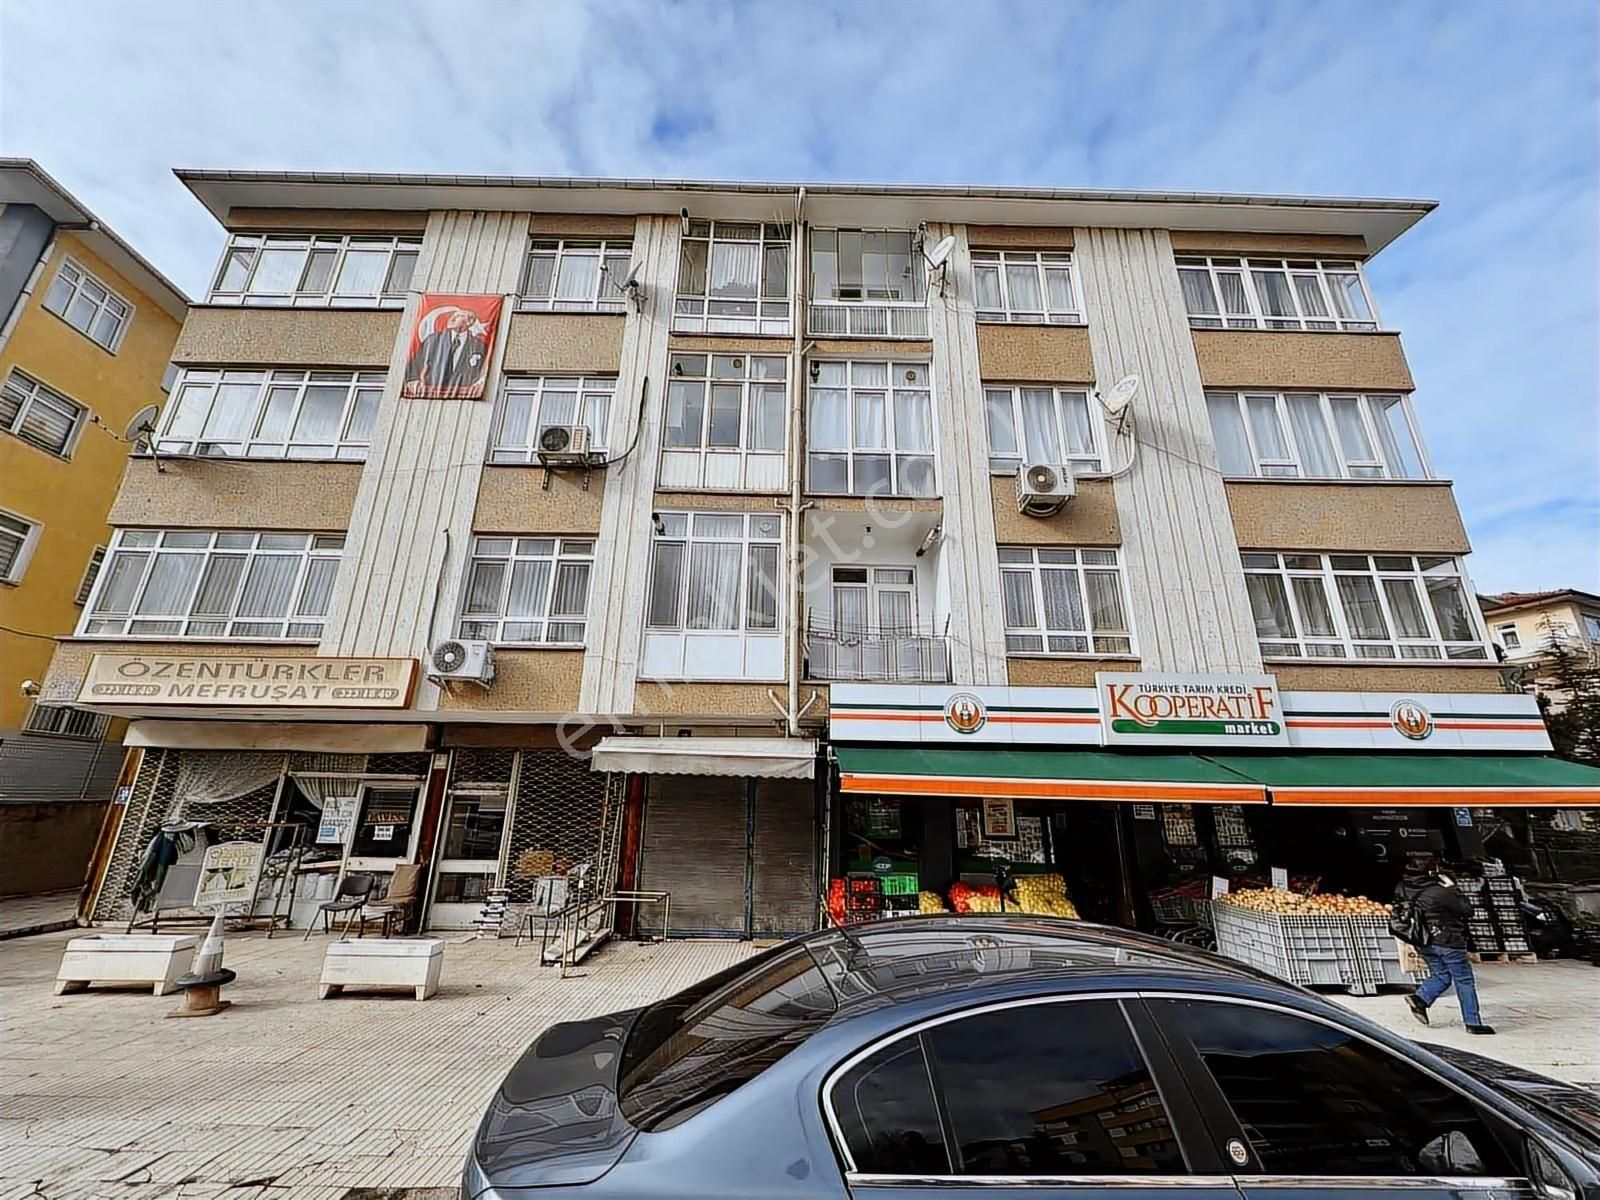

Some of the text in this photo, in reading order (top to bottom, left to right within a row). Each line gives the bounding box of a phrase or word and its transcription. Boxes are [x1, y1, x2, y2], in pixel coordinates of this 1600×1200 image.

[118, 657, 386, 681] ÖZENTÜRKLER
[168, 683, 327, 701] MEFRUŞAT
[1138, 682, 1246, 694] TÜRKİYE TARIM KREDİ
[1106, 684, 1273, 724] KOOPERATİF
[1224, 721, 1274, 735] market
